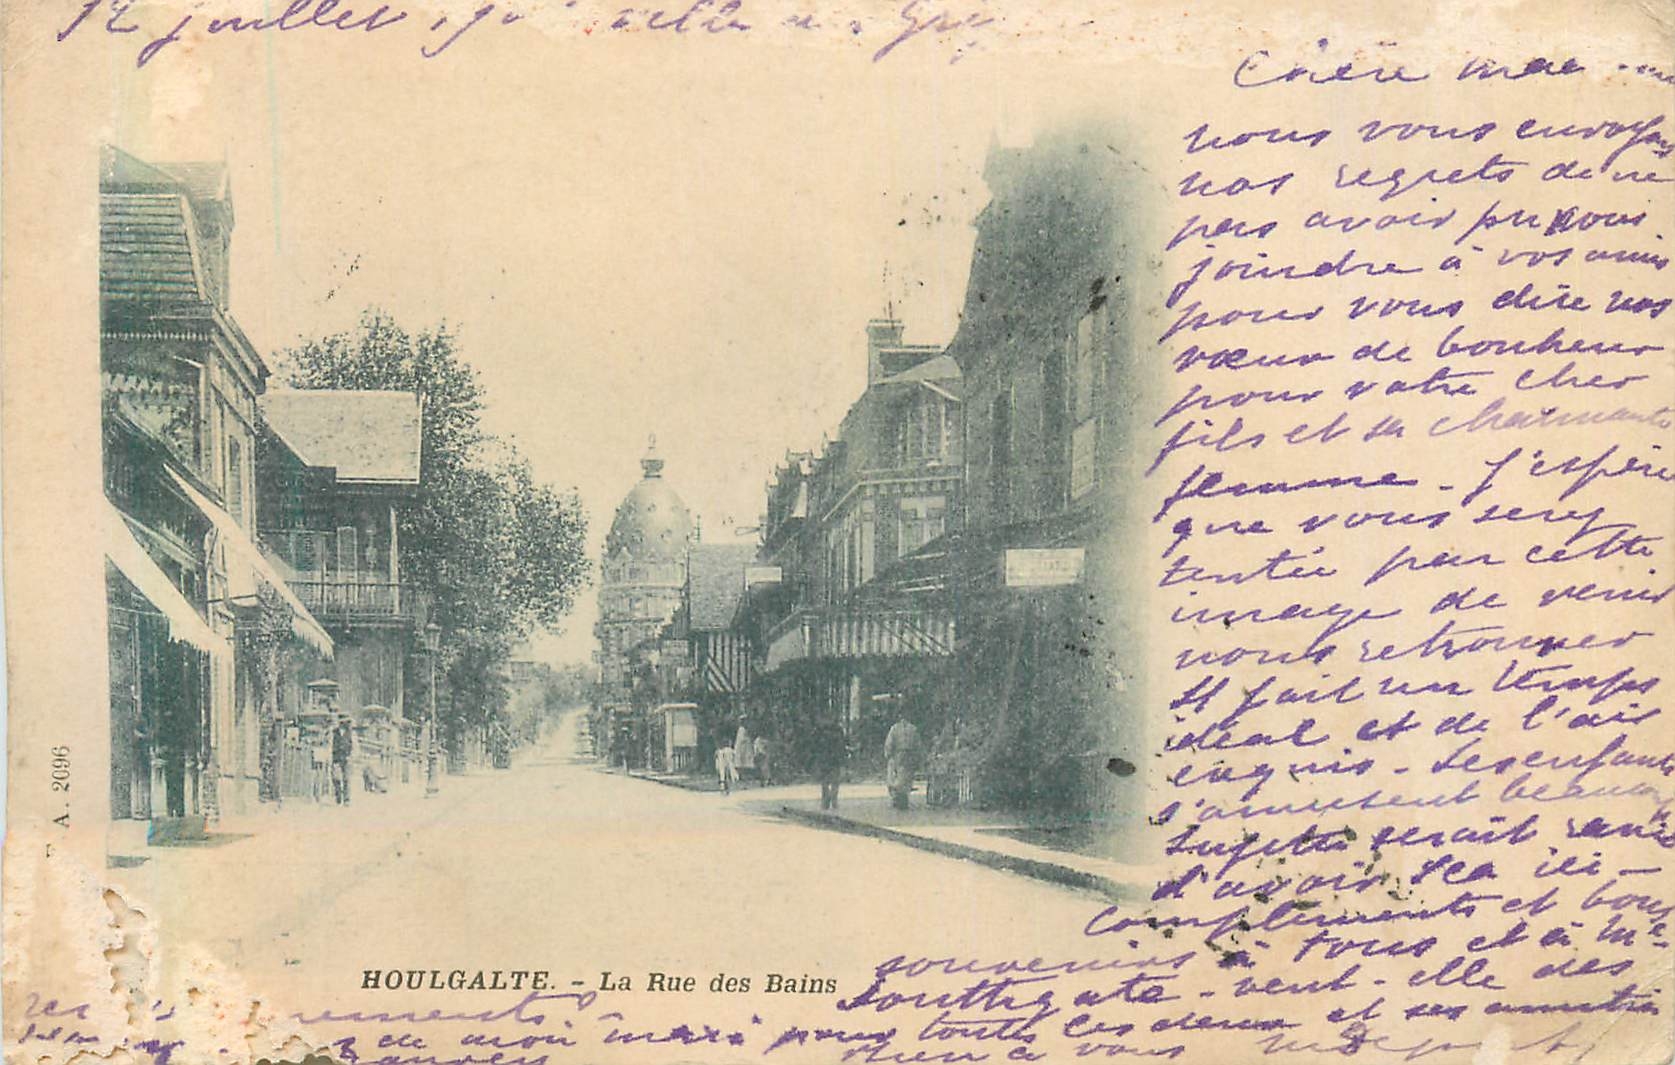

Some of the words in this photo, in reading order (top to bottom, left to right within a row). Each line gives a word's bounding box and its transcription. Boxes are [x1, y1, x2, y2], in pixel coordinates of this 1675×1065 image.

[1183, 123, 1330, 155] nous
[1358, 119, 1497, 143] vous
[1179, 171, 1294, 197] nos
[1334, 150, 1530, 203] regrets
[1542, 161, 1591, 180] de
[1611, 166, 1675, 185] ne
[1166, 215, 1278, 251] pas
[1304, 209, 1457, 233] avoir
[1165, 241, 1425, 312] joindre
[1499, 247, 1574, 268] vos
[1162, 296, 1324, 341] pour
[1348, 295, 1464, 321] vous
[1491, 283, 1588, 312] dire
[1351, 339, 1410, 363] de
[1435, 326, 1665, 359] bonheur
[1155, 384, 1323, 431] pour
[1343, 366, 1491, 400] votre
[1514, 360, 1650, 391] cher
[1143, 415, 1267, 480] fils
[1286, 412, 1349, 445] et
[1363, 405, 1405, 443] sa
[1162, 516, 1271, 561] que
[1302, 511, 1451, 535] vous
[1363, 545, 1504, 587] par
[1524, 534, 1666, 563] cette
[1430, 587, 1505, 615] de
[1539, 568, 1670, 608] venir
[1175, 640, 1336, 670] nous
[1358, 619, 1656, 666] retrouver
[1216, 675, 1369, 733] fait
[1377, 676, 1473, 697] un
[1491, 659, 1659, 708] temps
[1355, 710, 1423, 742] et
[1433, 711, 1489, 736] de
[1522, 693, 1660, 731] l'air
[51, 744, 72, 793] 2096
[51, 803, 71, 829] A.
[1369, 815, 1539, 850] serait
[1151, 861, 1382, 901] d'avoir
[1535, 847, 1601, 878] ici
[1502, 887, 1558, 917] et
[875, 940, 1195, 979] souvenirs
[1294, 929, 1438, 962] tous
[1467, 919, 1528, 953] et
[1533, 959, 1633, 979] des
[361, 969, 555, 990] HOULGALTE.
[599, 971, 631, 991] La
[647, 972, 696, 992] Rue
[709, 973, 751, 993] des
[764, 974, 837, 994] Bains
[1327, 997, 1382, 1023] et
